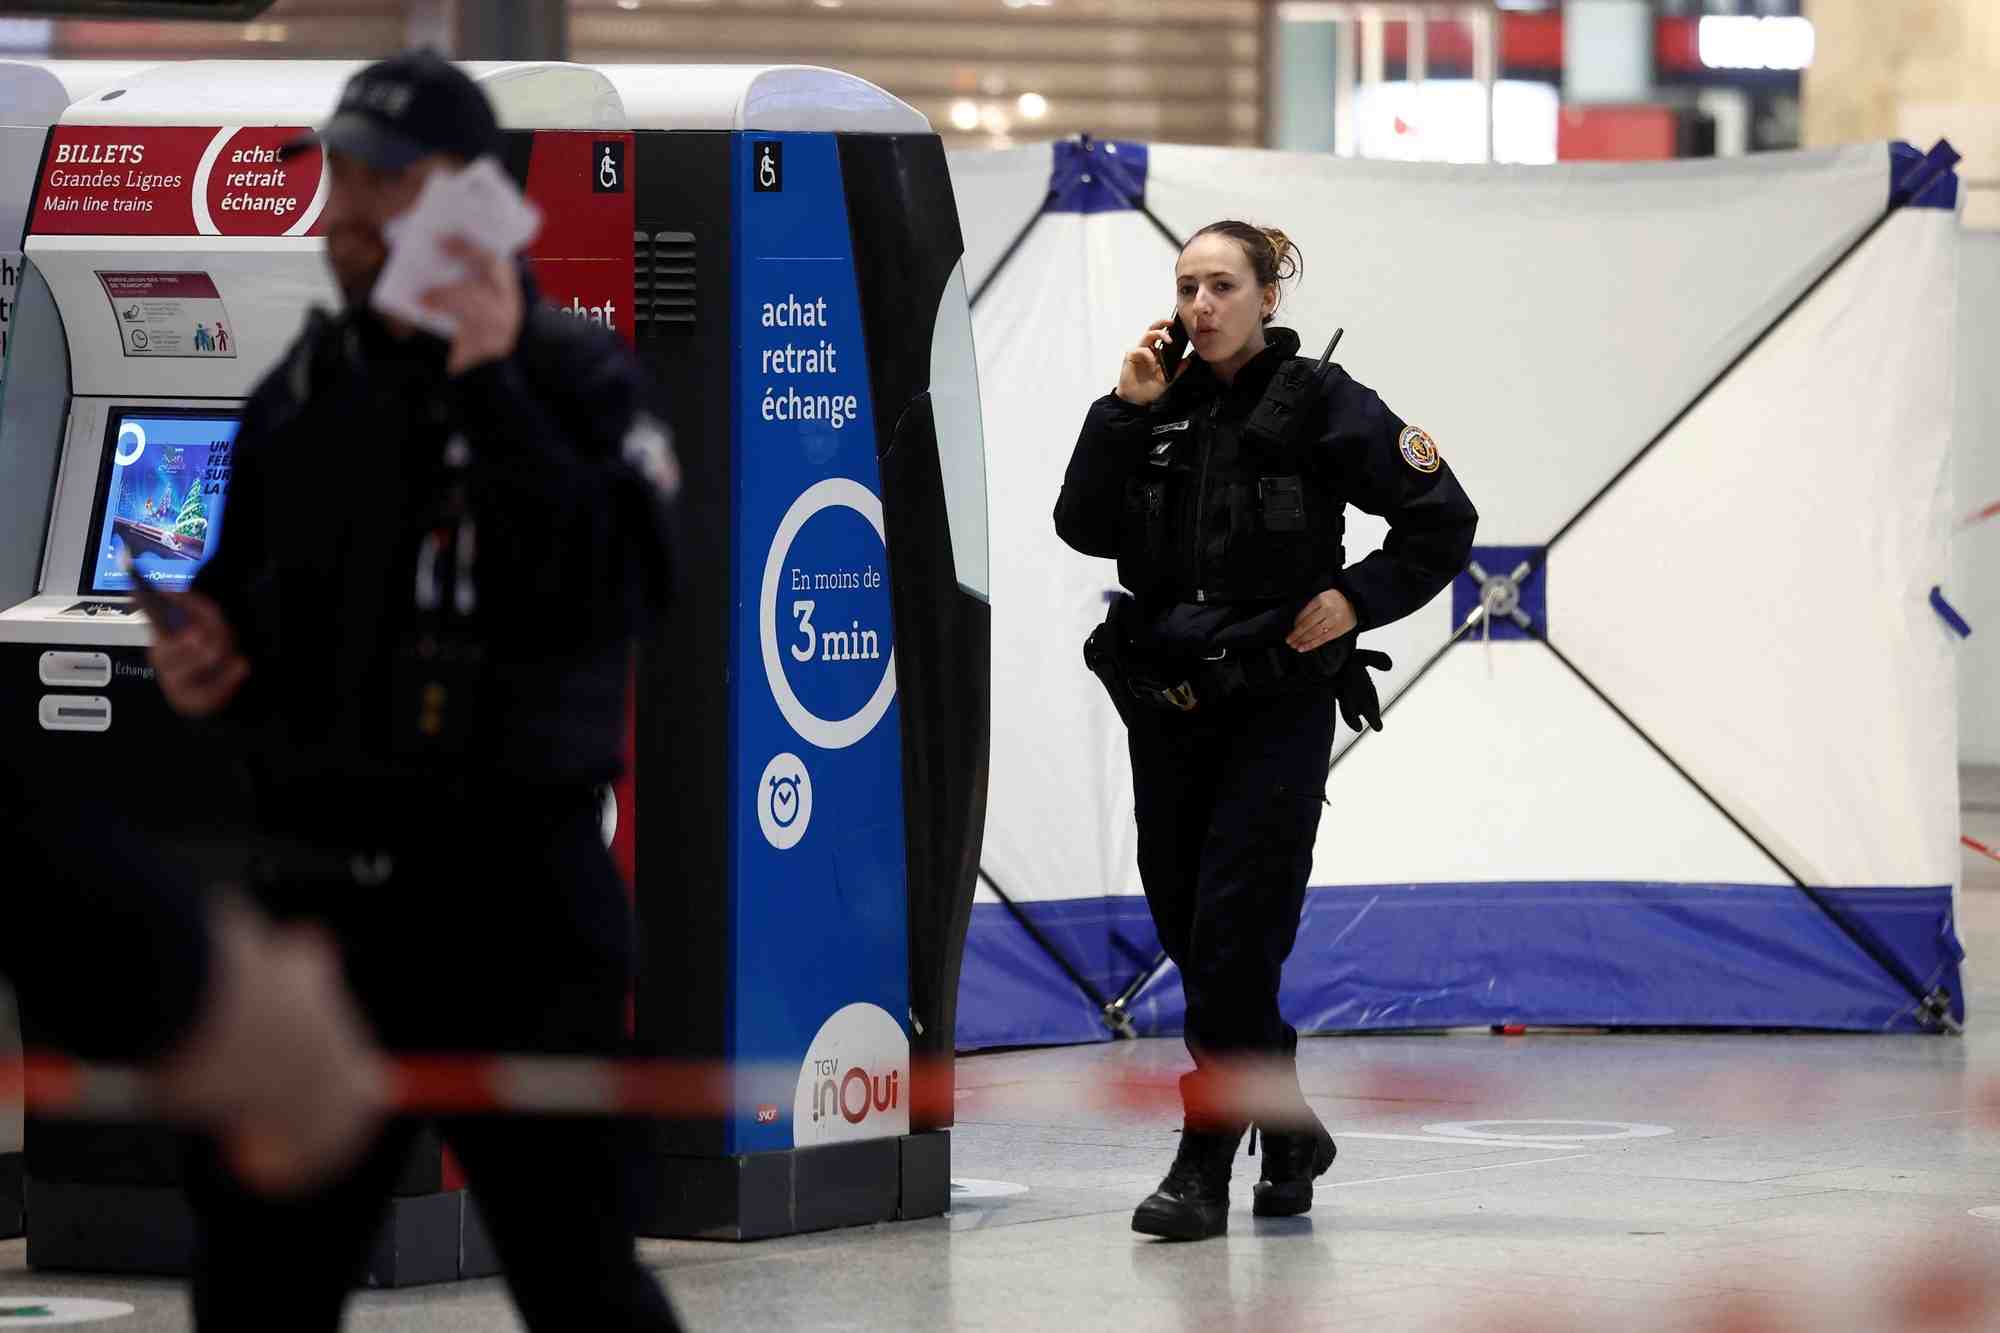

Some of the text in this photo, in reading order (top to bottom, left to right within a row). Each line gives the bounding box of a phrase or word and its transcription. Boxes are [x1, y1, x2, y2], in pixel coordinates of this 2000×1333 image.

[55, 144, 145, 164] BILLETS
[50, 169, 182, 192] Grandes Lignes
[226, 168, 286, 187] retrait
[44, 195, 153, 212] Main line trains
[221, 192, 297, 216] échange
[761, 293, 828, 328] achat
[762, 339, 837, 374] retrait
[761, 386, 857, 429] échange
[791, 565, 881, 590] En moins de
[791, 600, 880, 662] 3 min
[815, 1058, 839, 1076] TGV
